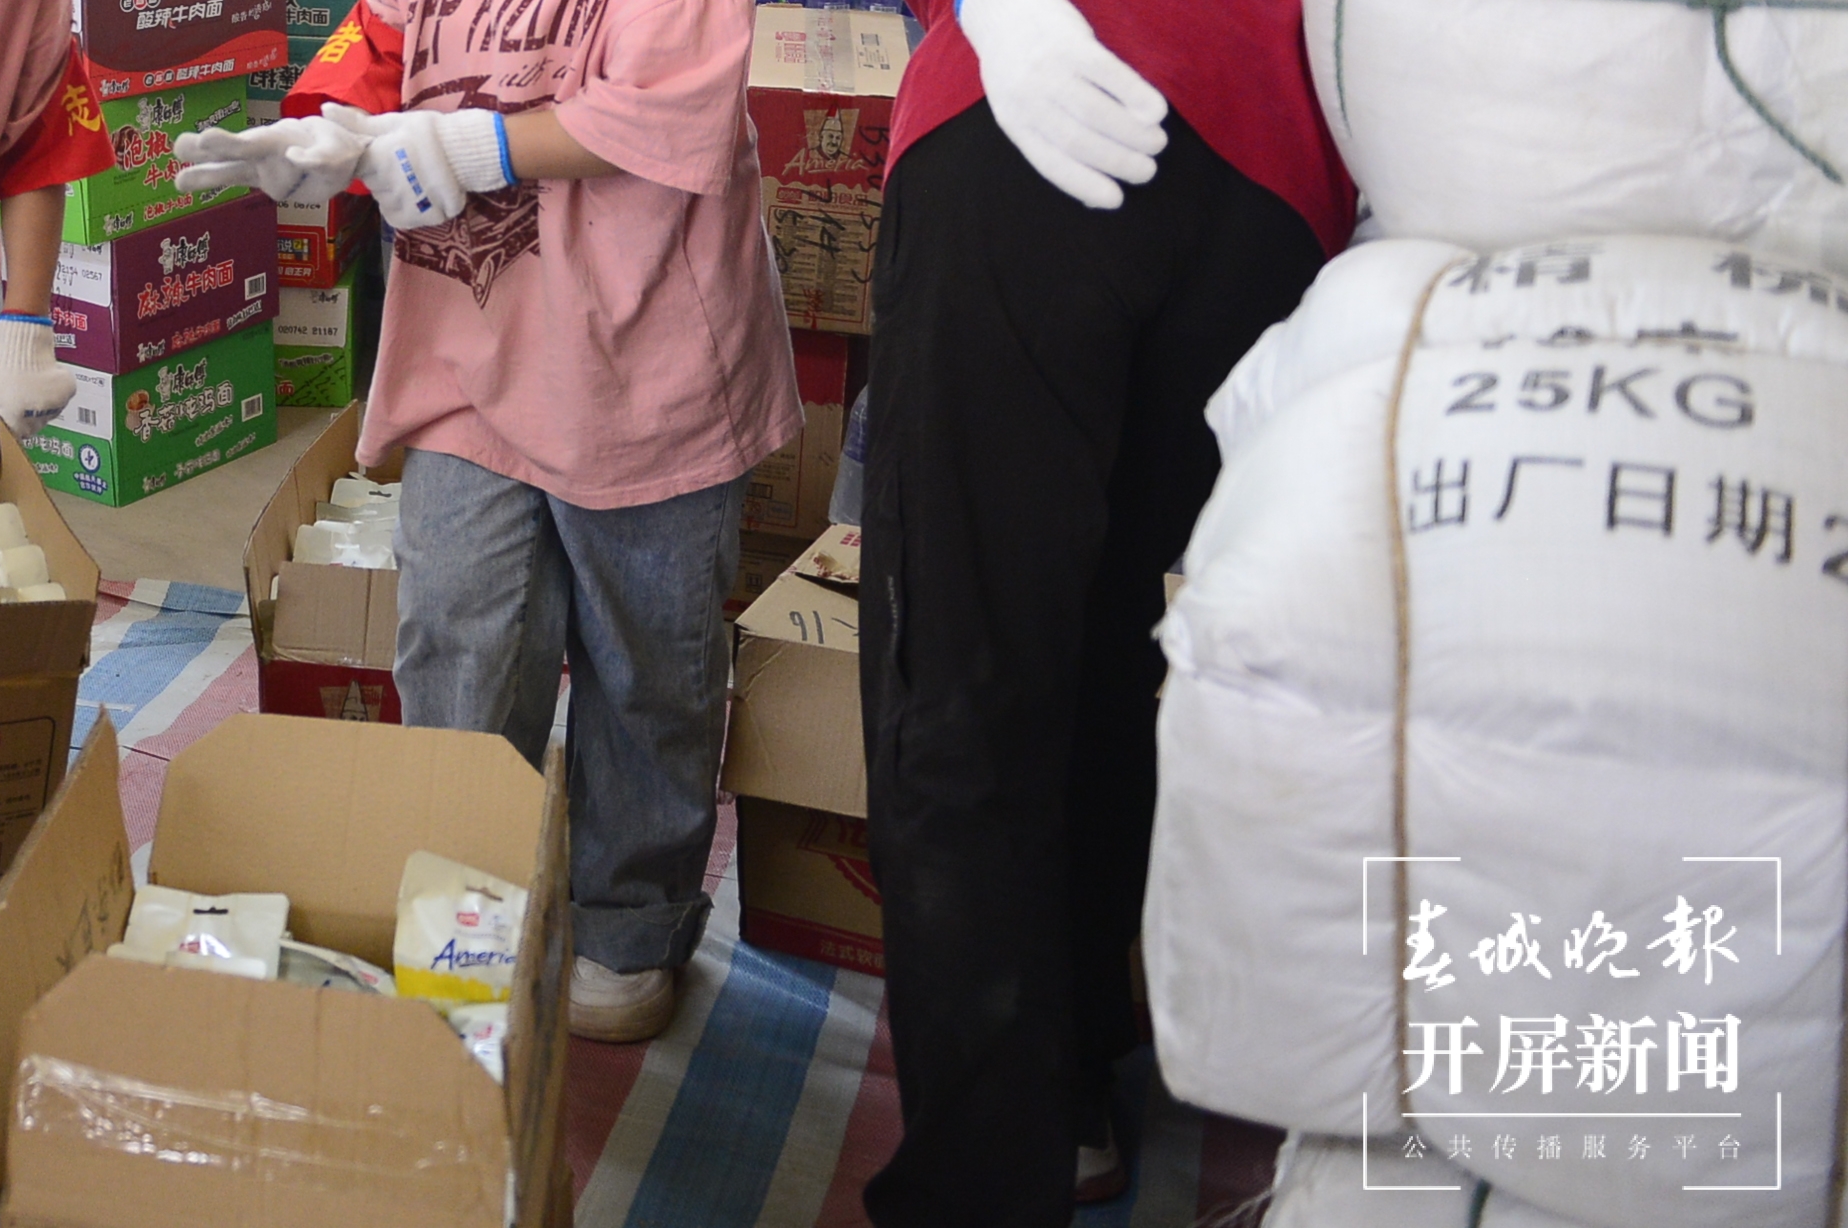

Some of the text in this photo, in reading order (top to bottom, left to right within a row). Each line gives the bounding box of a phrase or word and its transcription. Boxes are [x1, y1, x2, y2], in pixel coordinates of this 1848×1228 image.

[317, 21, 363, 64] 者
[175, 58, 235, 81] 酸辣牛肉面
[151, 92, 185, 125] 康师傅
[123, 131, 172, 171] 泡椒
[143, 192, 193, 221] 泡椒牛肉面
[174, 231, 211, 266] 康师傅
[137, 259, 235, 320] 麻辣牛肉面
[173, 358, 208, 392] 康师傅
[134, 380, 234, 443] 香菇炖鸡面
[1445, 366, 1756, 429] 25KG
